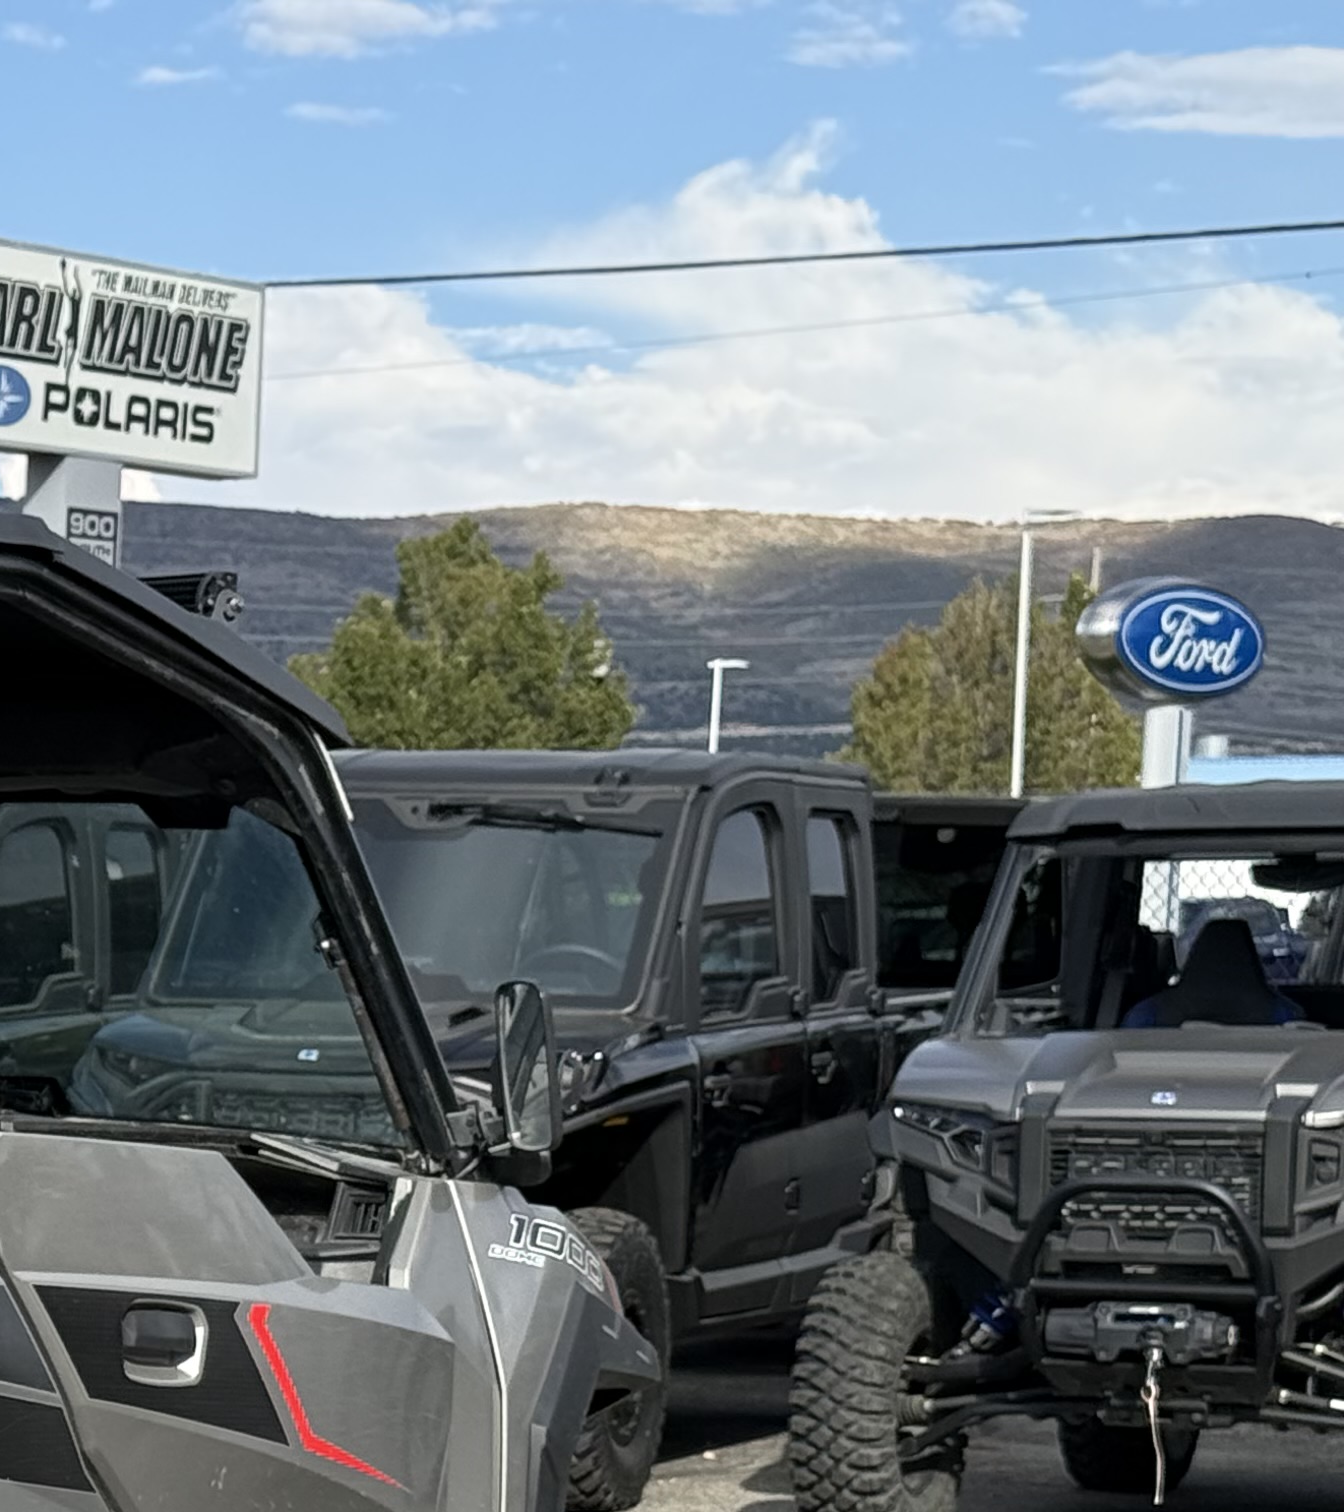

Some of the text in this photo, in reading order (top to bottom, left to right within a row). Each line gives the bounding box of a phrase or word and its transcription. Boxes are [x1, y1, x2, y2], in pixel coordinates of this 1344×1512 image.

[79, 294, 250, 393] MALONE
[42, 381, 216, 444] POLARIS
[70, 511, 115, 538] 900
[1149, 603, 1245, 675] Ford
[509, 1213, 604, 1292] 1000
